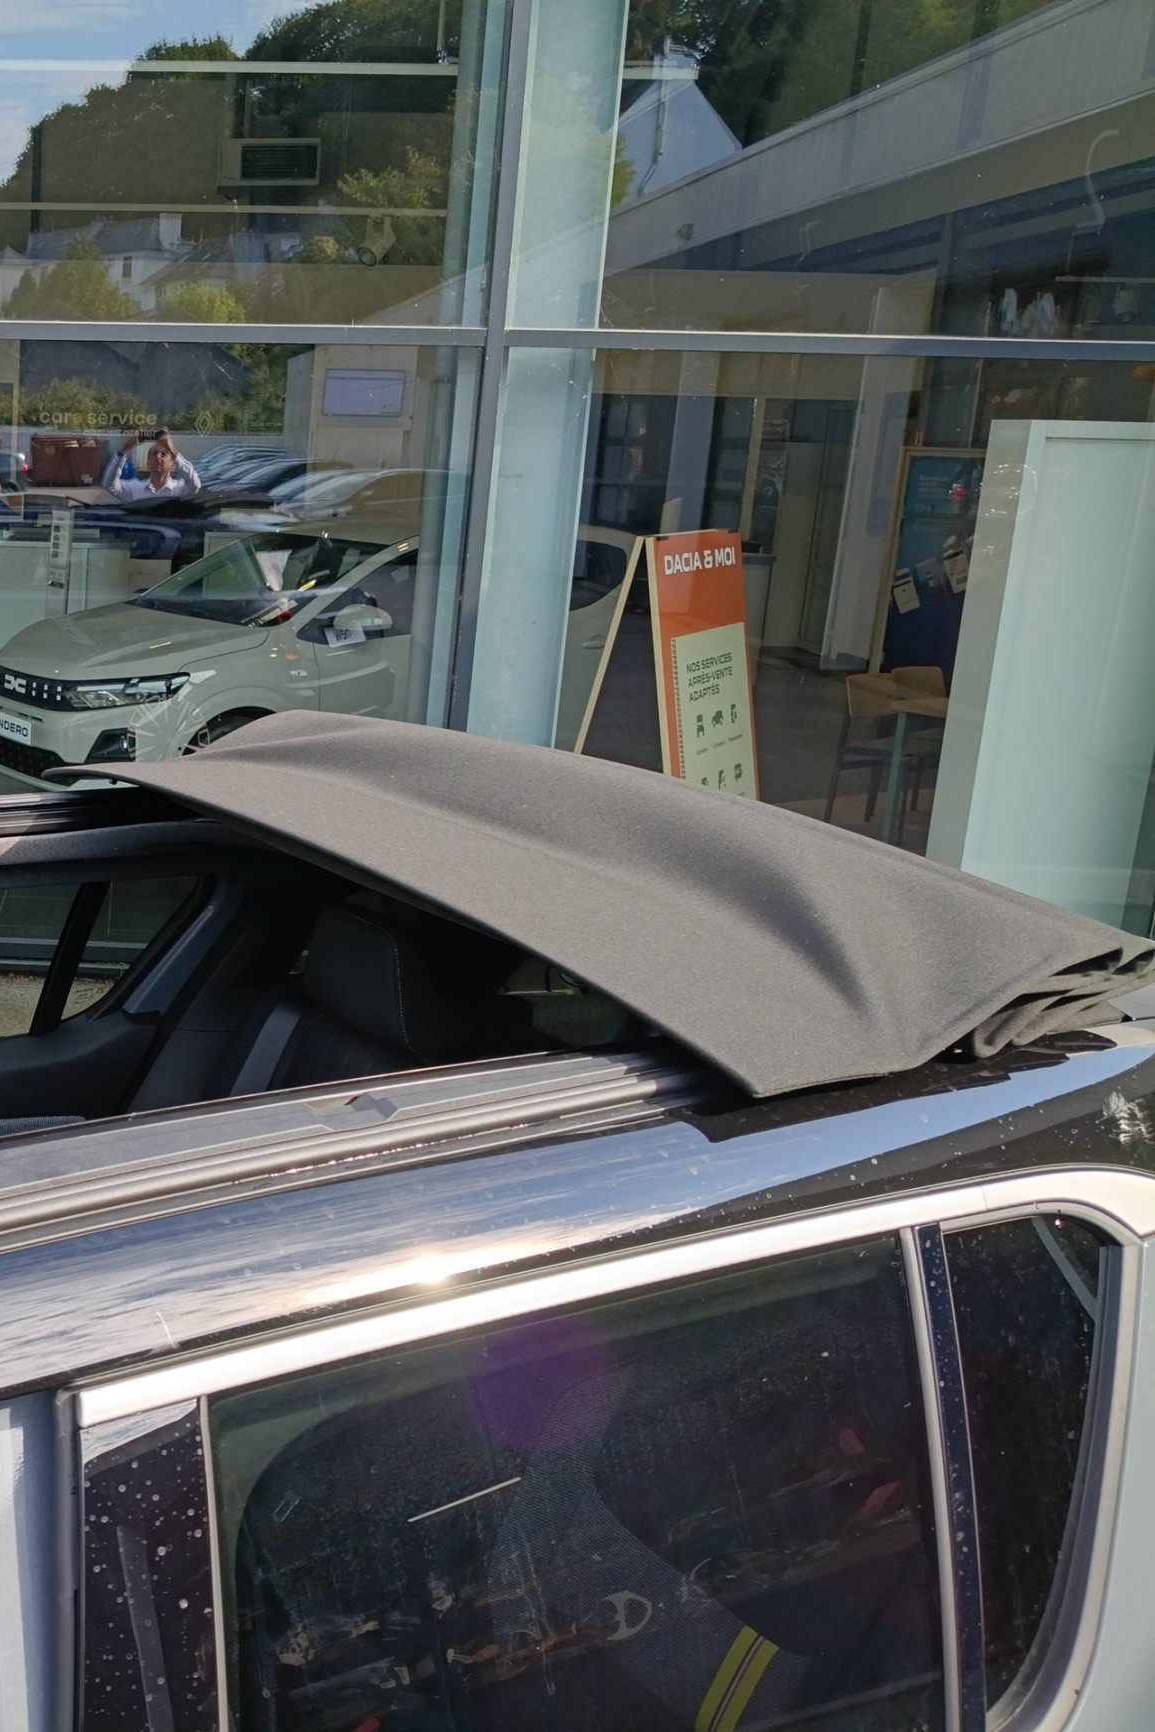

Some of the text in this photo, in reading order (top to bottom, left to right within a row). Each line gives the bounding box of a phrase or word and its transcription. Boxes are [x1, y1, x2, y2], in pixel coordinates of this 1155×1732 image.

[39, 409, 157, 425] care service
[664, 546, 736, 576] DACIA & MOI
[686, 652, 732, 674] NOS SERVICES
[689, 683, 720, 702] ADAPTÉS
